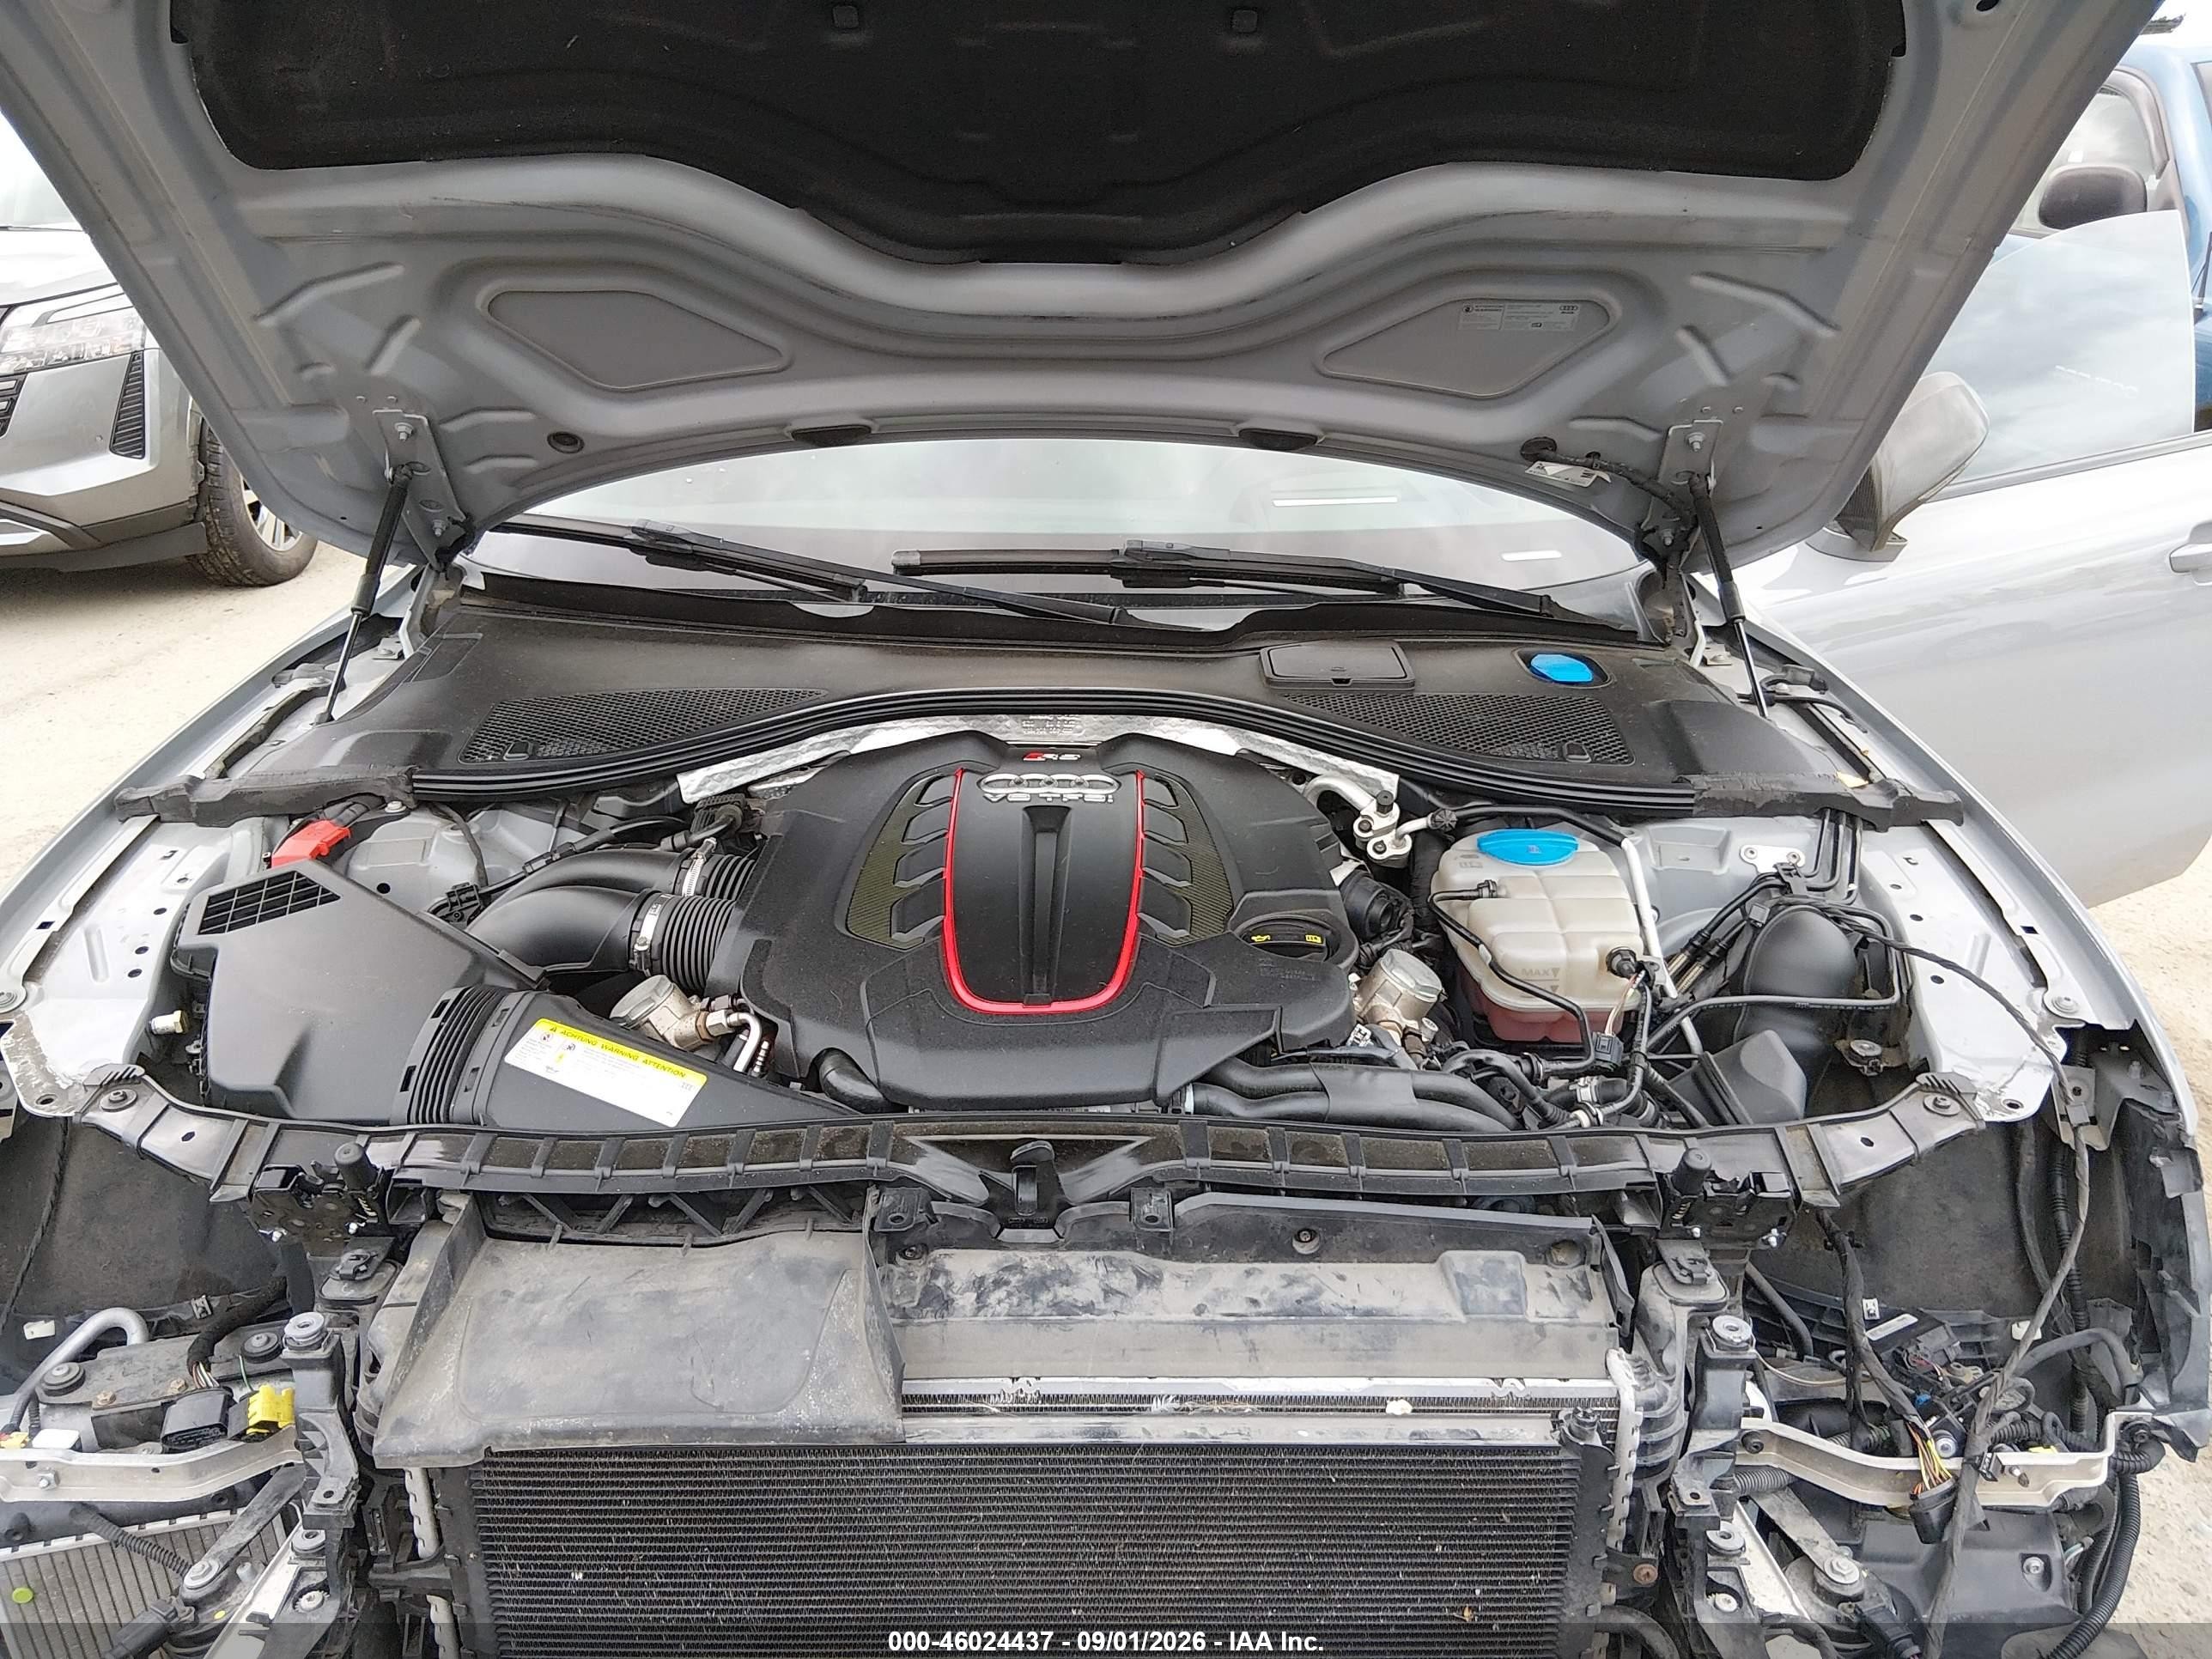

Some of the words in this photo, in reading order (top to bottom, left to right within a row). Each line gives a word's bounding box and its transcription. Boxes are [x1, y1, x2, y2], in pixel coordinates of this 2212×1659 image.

[1521, 968, 1551, 977] MAX
[560, 1030, 599, 1046] ACHTUNG
[600, 1042, 639, 1061] WARNING
[641, 1058, 686, 1078] ATTENTION
